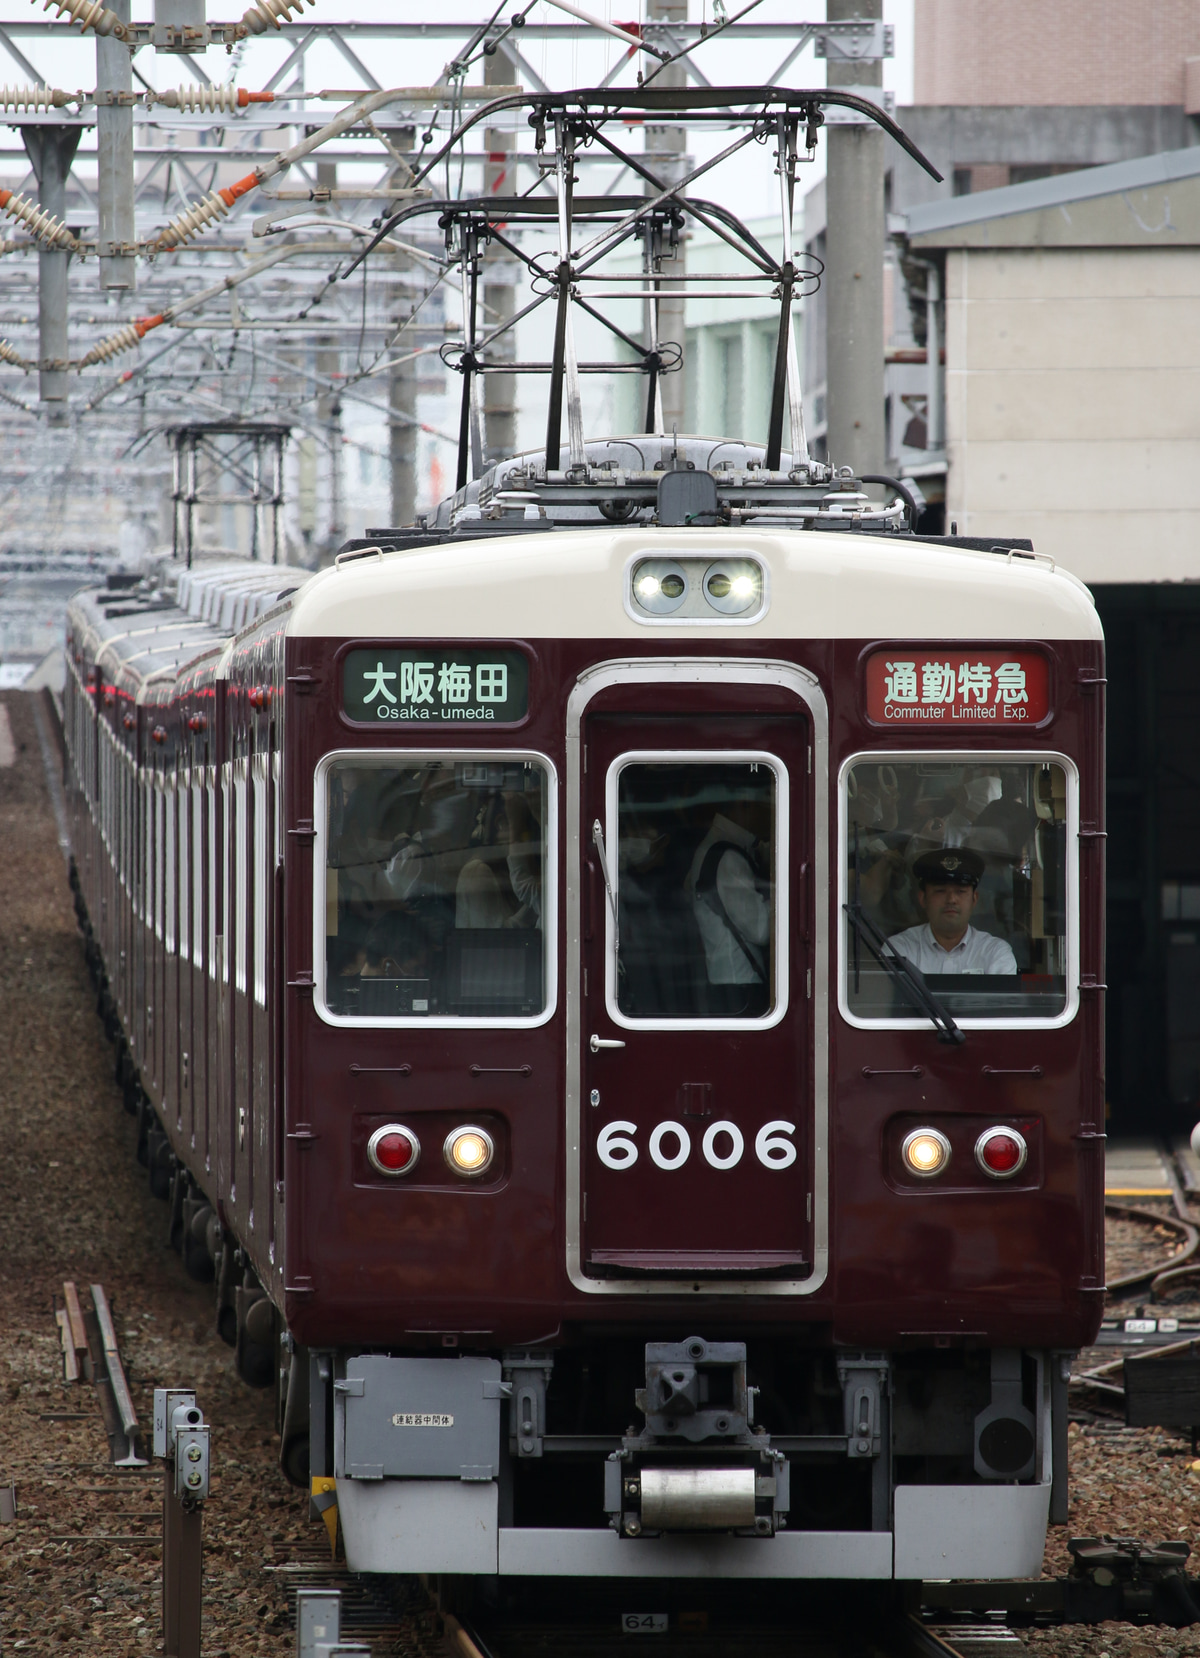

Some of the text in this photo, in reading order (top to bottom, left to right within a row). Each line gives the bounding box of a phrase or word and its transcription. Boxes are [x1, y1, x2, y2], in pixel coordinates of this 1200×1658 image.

[363, 661, 508, 704] 大阪梅田
[884, 661, 1029, 704] 通勤特急
[376, 705, 495, 720] Osaka-umeda
[884, 704, 1029, 720] Commuter Limited Exp.
[596, 1120, 797, 1171] 6006
[396, 1414, 450, 1426] 連結器中間体
